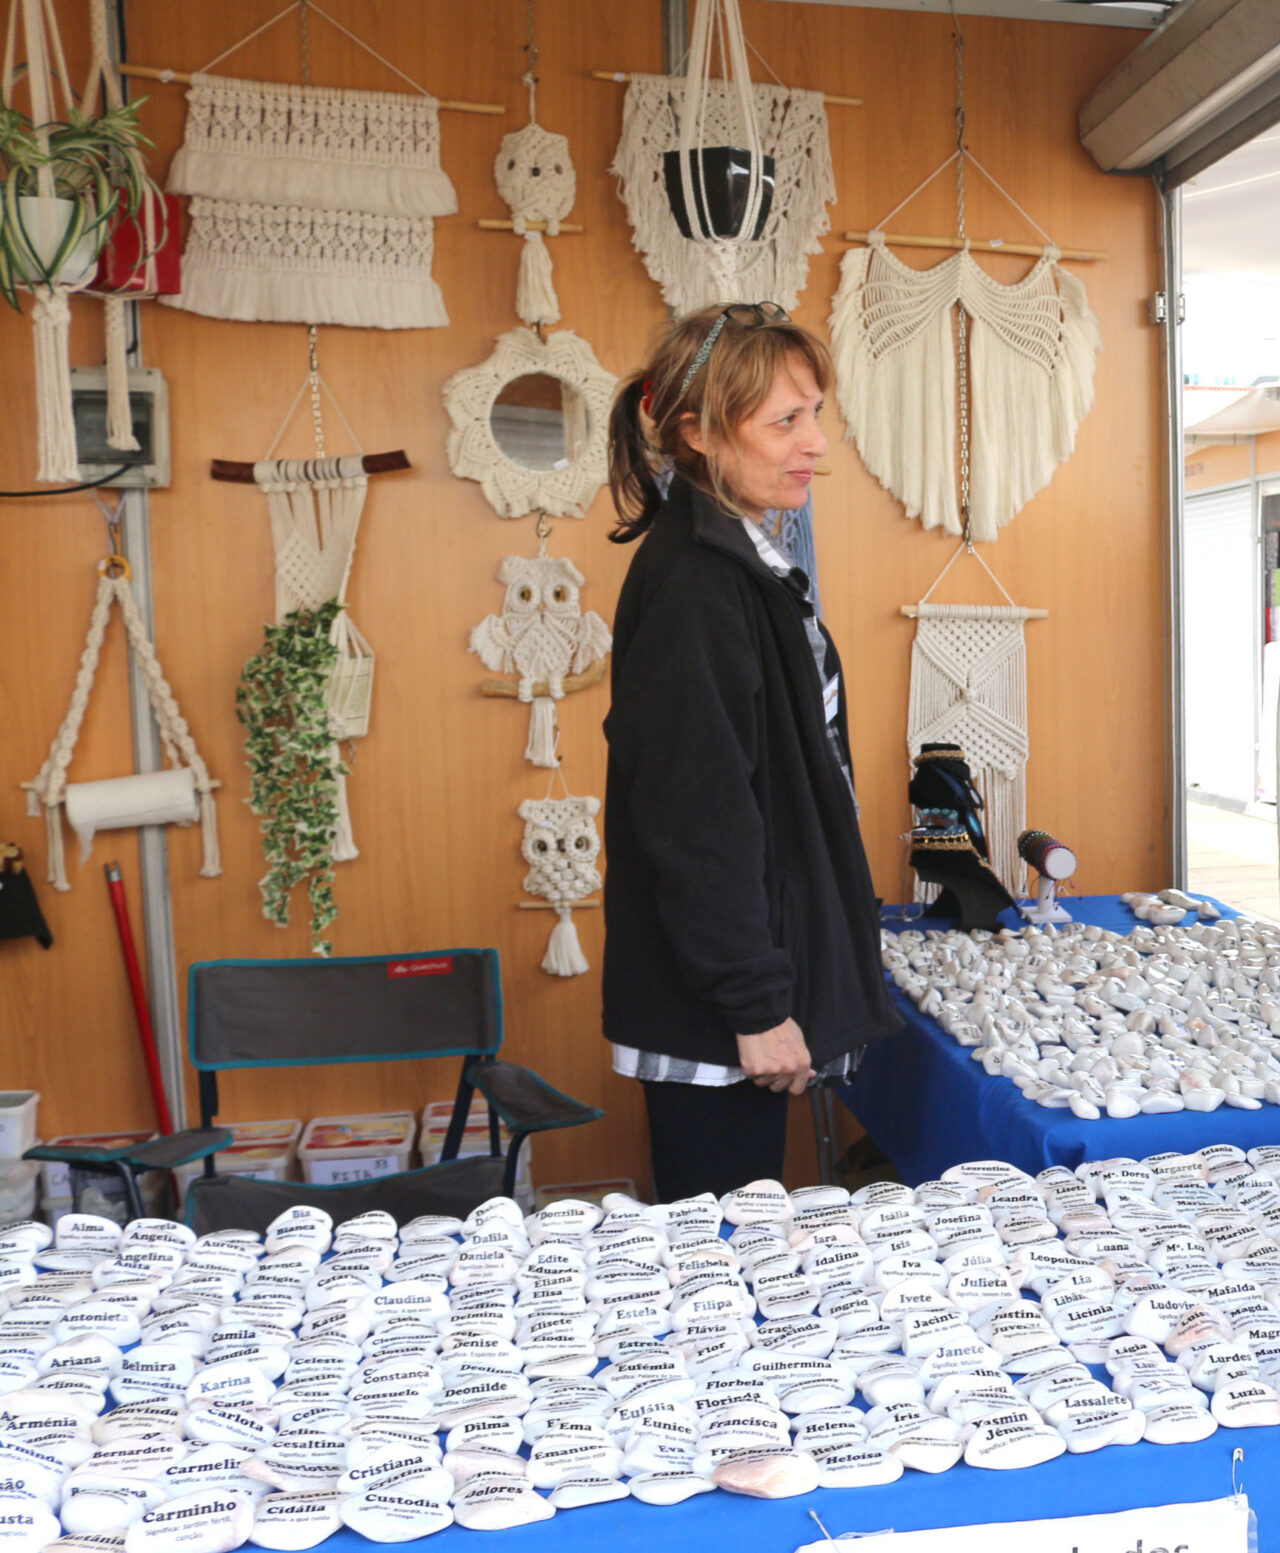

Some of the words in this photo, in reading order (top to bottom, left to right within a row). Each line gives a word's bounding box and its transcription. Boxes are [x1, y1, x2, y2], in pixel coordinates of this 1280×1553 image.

[1150, 1162, 1202, 1174] Margarete
[1122, 1170, 1150, 1179] Dores
[1056, 1185, 1087, 1193] Liseta
[737, 1190, 786, 1200] Germana
[992, 1194, 1038, 1202] Leandra
[292, 1210, 310, 1218] Bia
[934, 1214, 981, 1224] Josefina
[72, 1222, 104, 1232] Alma
[276, 1224, 316, 1236] Bianca
[600, 1235, 654, 1251] Ernestina
[739, 1238, 774, 1248] Gisela
[814, 1234, 837, 1244] Iara
[116, 1252, 173, 1262] Angelina
[460, 1251, 504, 1260] Daniela
[538, 1255, 569, 1264] Edite
[816, 1250, 859, 1266] Idalina
[114, 1260, 150, 1270] Anita
[902, 1260, 920, 1268] Iva
[534, 1276, 572, 1288] Eliana
[961, 1278, 1007, 1288] Julieta
[533, 1290, 562, 1298] Elisa
[1208, 1284, 1256, 1298] Mafalda
[374, 1295, 432, 1305] Claudina
[900, 1294, 932, 1302] Ivete
[693, 1300, 732, 1312] Filipa
[617, 1308, 656, 1319] Estela
[160, 1320, 189, 1332] Bela
[312, 1312, 346, 1330] Kátia
[530, 1318, 572, 1333] Elisete
[687, 1324, 726, 1335] Flávia
[212, 1330, 256, 1342] Camila
[453, 1339, 498, 1350] Denise
[936, 1345, 984, 1358] Janete
[50, 1354, 101, 1368] Ariana
[122, 1360, 176, 1372] Belmira
[618, 1362, 675, 1371] Eufémia
[752, 1360, 831, 1371] Guilhermina
[364, 1370, 430, 1384] Constança
[201, 1376, 251, 1393] Karina
[445, 1382, 507, 1397] Deonilde
[706, 1379, 764, 1390] Florbela
[354, 1390, 419, 1400] Consuelo
[1230, 1388, 1265, 1400] Luzia
[213, 1400, 254, 1408] Carla
[1065, 1396, 1127, 1407] Lassalete
[6, 1418, 77, 1430] Arménia
[208, 1408, 264, 1432] Carlota
[642, 1416, 692, 1434] Eunice
[709, 1418, 777, 1430] Francisca
[464, 1421, 510, 1432] Dilma
[560, 1422, 592, 1431] Ema
[806, 1422, 855, 1432] Helena
[92, 1446, 173, 1459] Bernardete
[350, 1456, 423, 1480] Cristiana
[142, 1500, 236, 1523] Carminho
[267, 1504, 325, 1514] Cidália
